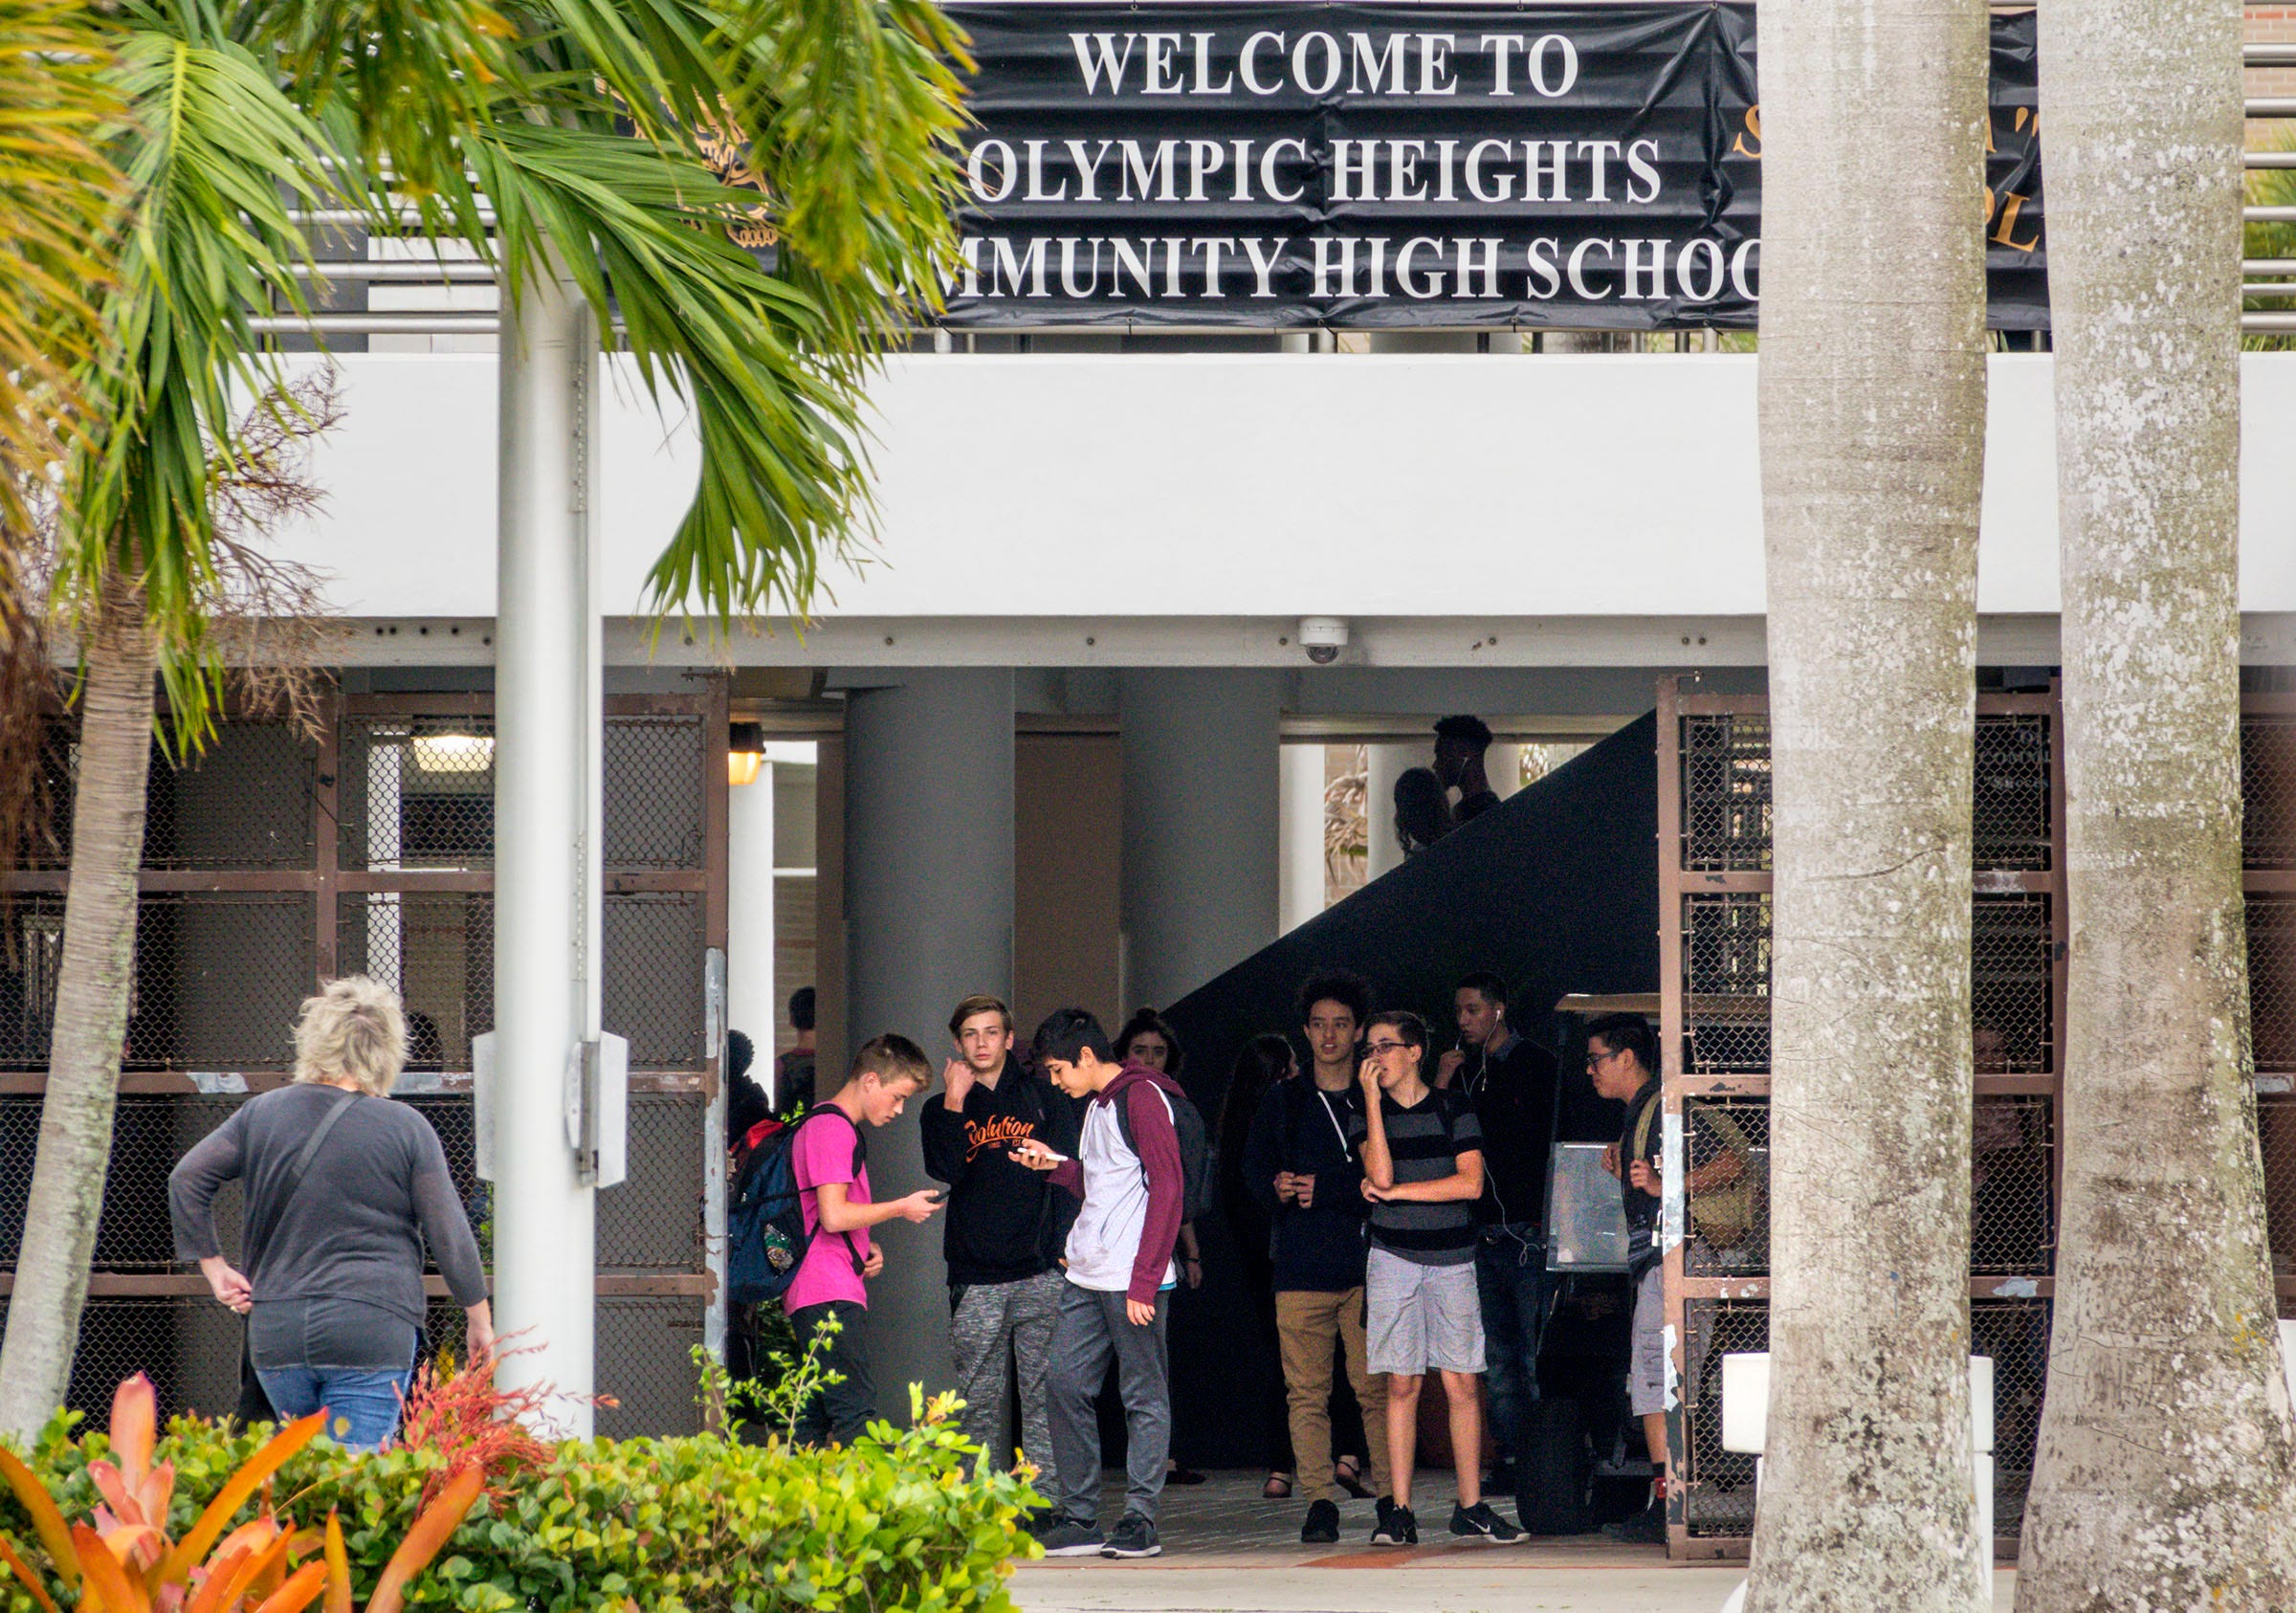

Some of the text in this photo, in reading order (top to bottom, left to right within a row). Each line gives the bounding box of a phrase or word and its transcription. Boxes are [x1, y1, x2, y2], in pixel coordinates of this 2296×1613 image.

[1068, 31, 1579, 99] WELCOME TO
[967, 138, 1662, 205] OLYMPIC HEIGHTS
[1308, 235, 1505, 299] HIGH
[1526, 235, 1759, 302] SCHOO
